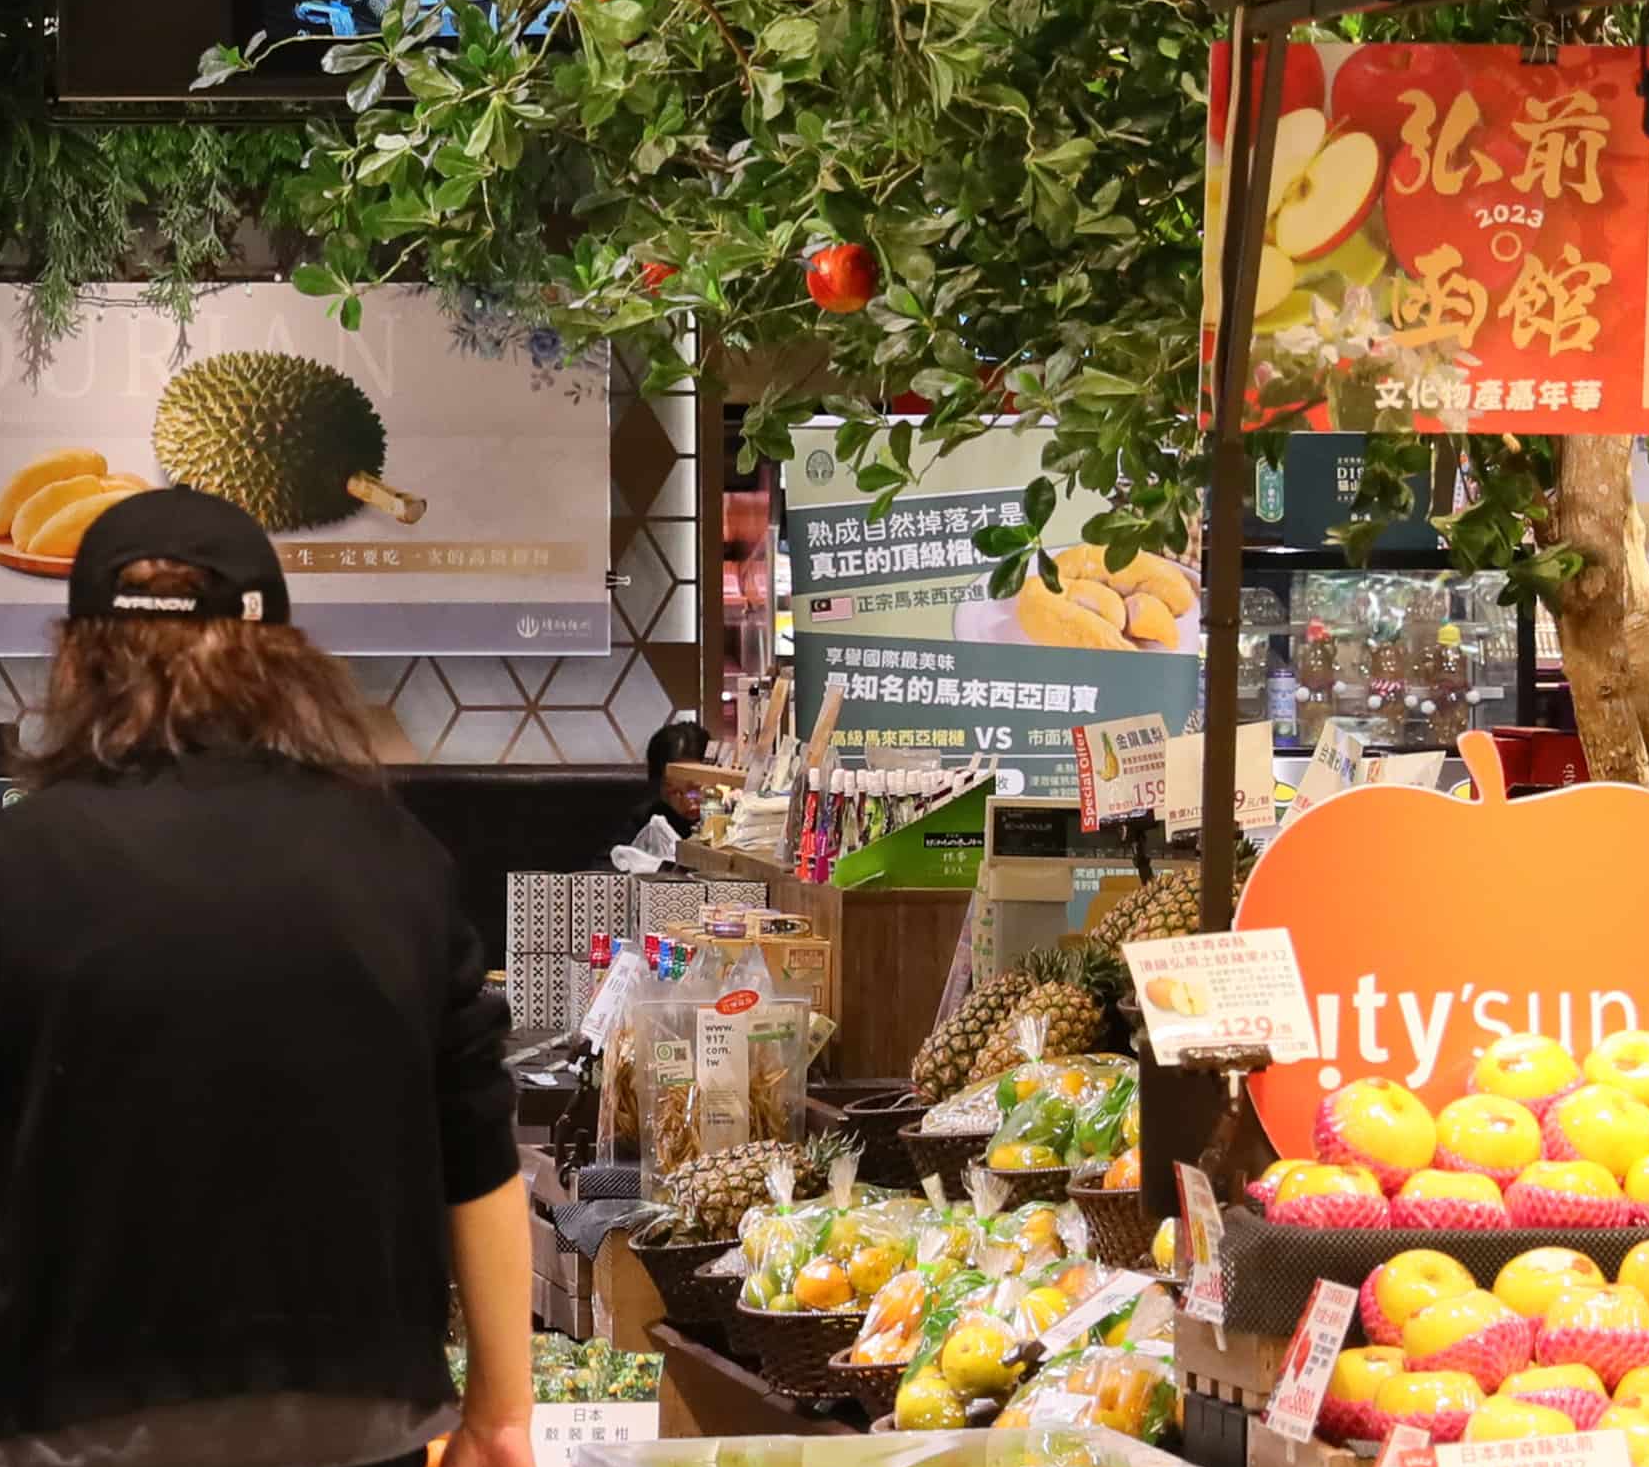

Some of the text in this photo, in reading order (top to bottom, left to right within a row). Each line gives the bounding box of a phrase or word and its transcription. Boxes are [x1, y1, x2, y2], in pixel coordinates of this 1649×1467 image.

[1390, 89, 1611, 205] 弘前
[1474, 203, 1545, 230] 2023
[1374, 379, 1603, 412] 文化物產嘉年華
[806, 501, 1026, 548] 熟成自然掉落才是
[825, 646, 956, 672] 享譽國際最美味
[825, 671, 1100, 715] 最知名的馬來西亞國寶
[975, 725, 1013, 751] VS
[1079, 773, 1096, 828] Special
[573, 1408, 604, 1423] 日本
